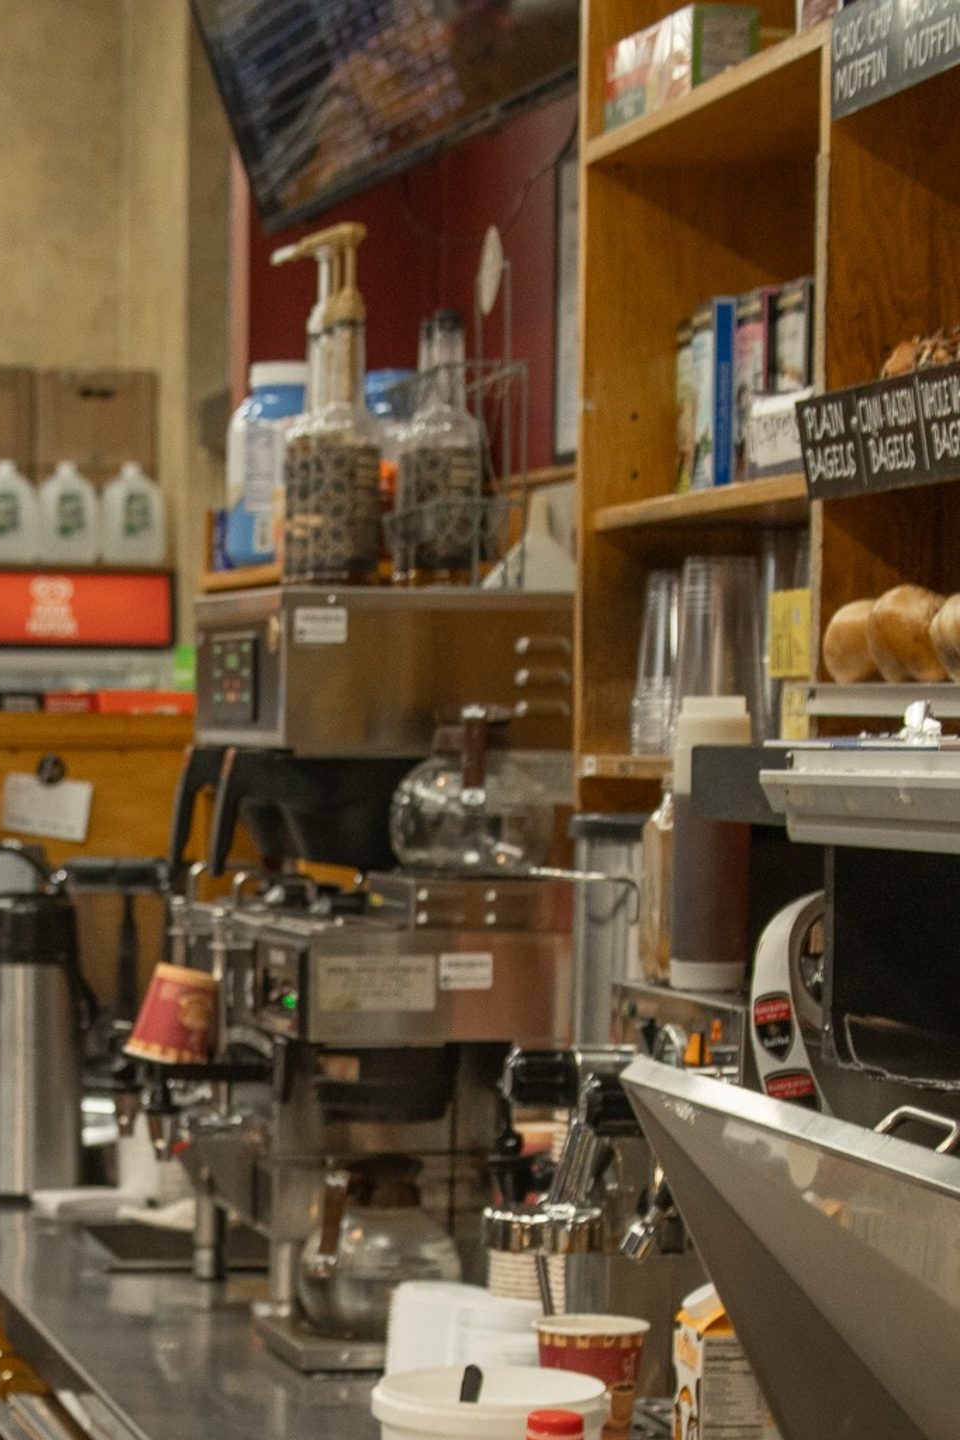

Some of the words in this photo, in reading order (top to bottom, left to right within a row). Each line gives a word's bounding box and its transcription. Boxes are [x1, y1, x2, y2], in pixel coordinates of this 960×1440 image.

[803, 399, 846, 442] PLAIN
[805, 440, 857, 483] BAGELS
[867, 431, 917, 475] BAGELS
